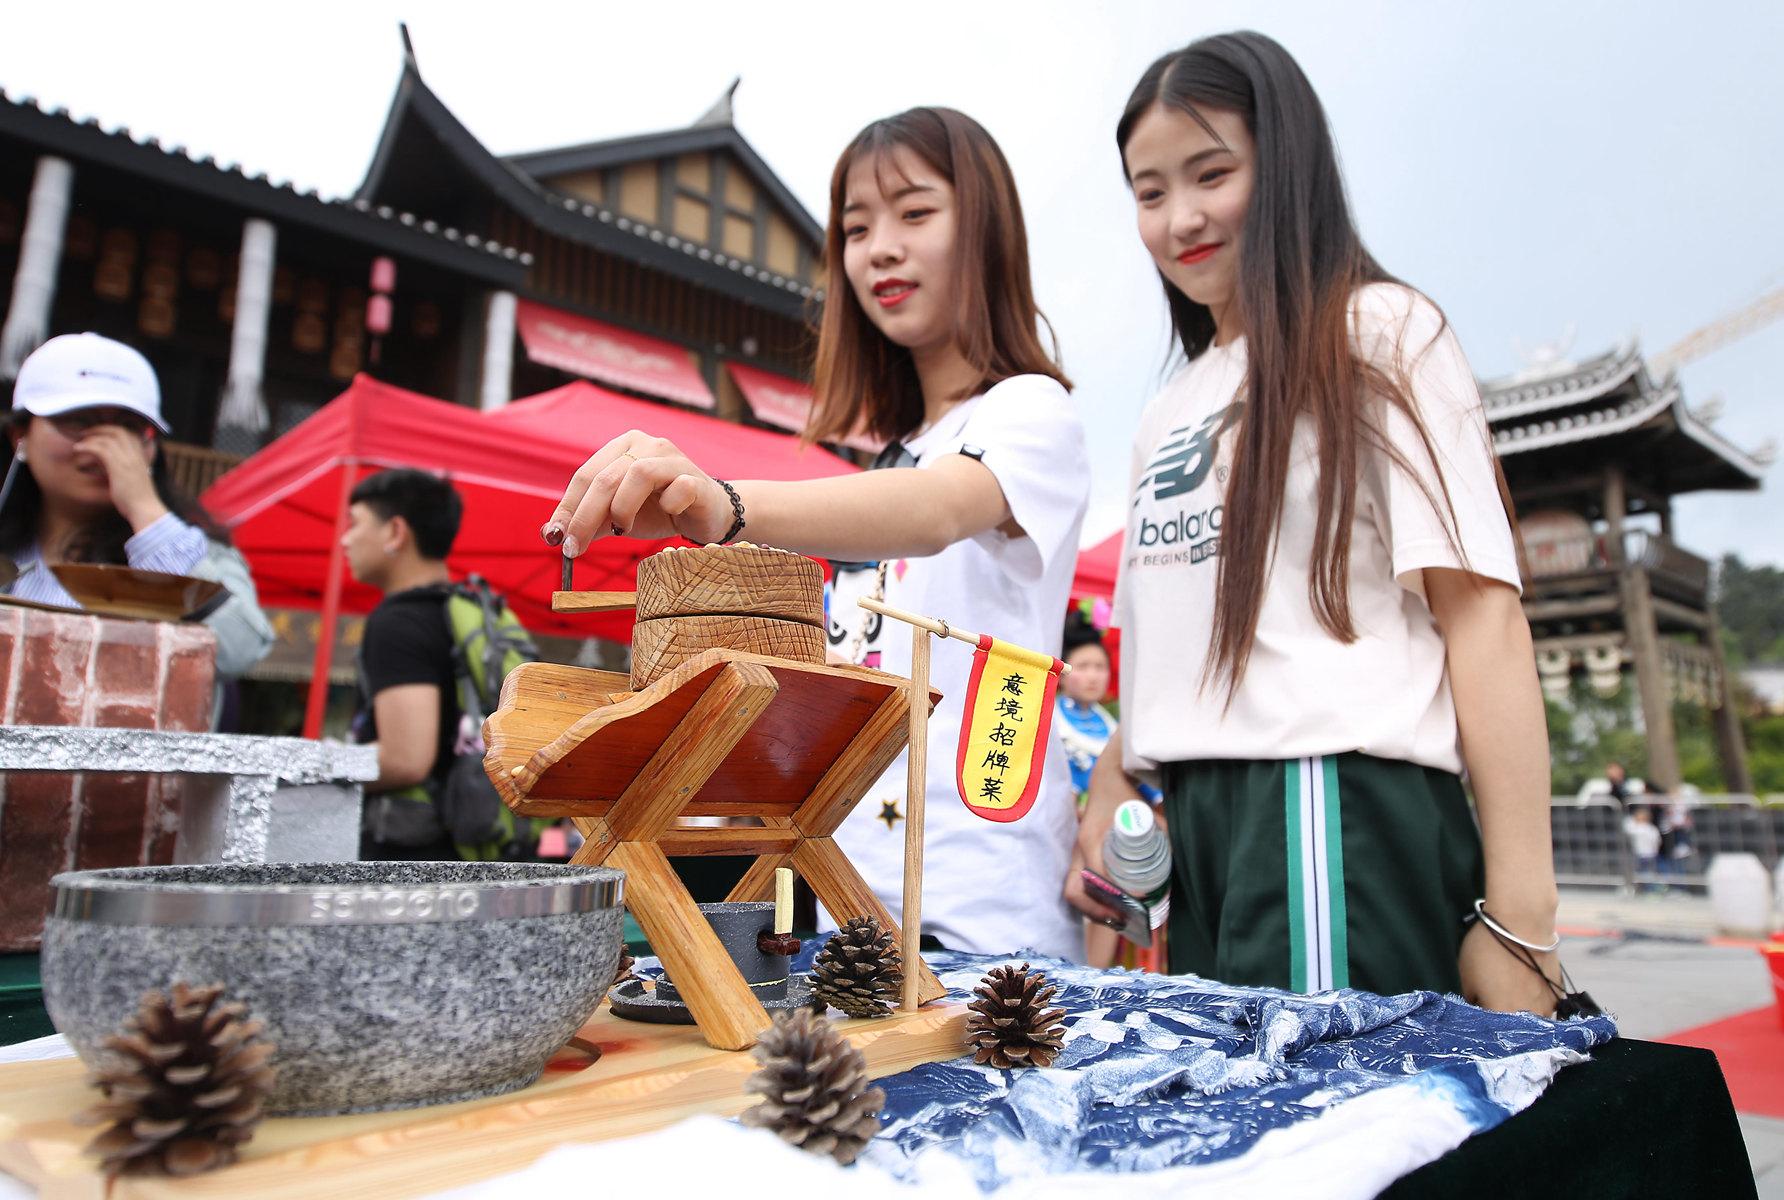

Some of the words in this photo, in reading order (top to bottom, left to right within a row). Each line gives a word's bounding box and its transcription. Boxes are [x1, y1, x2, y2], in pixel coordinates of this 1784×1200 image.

[1138, 505, 1224, 547] balanc
[1143, 551, 1190, 567] BEGINS
[979, 672, 1028, 803] 意境招牌菜
